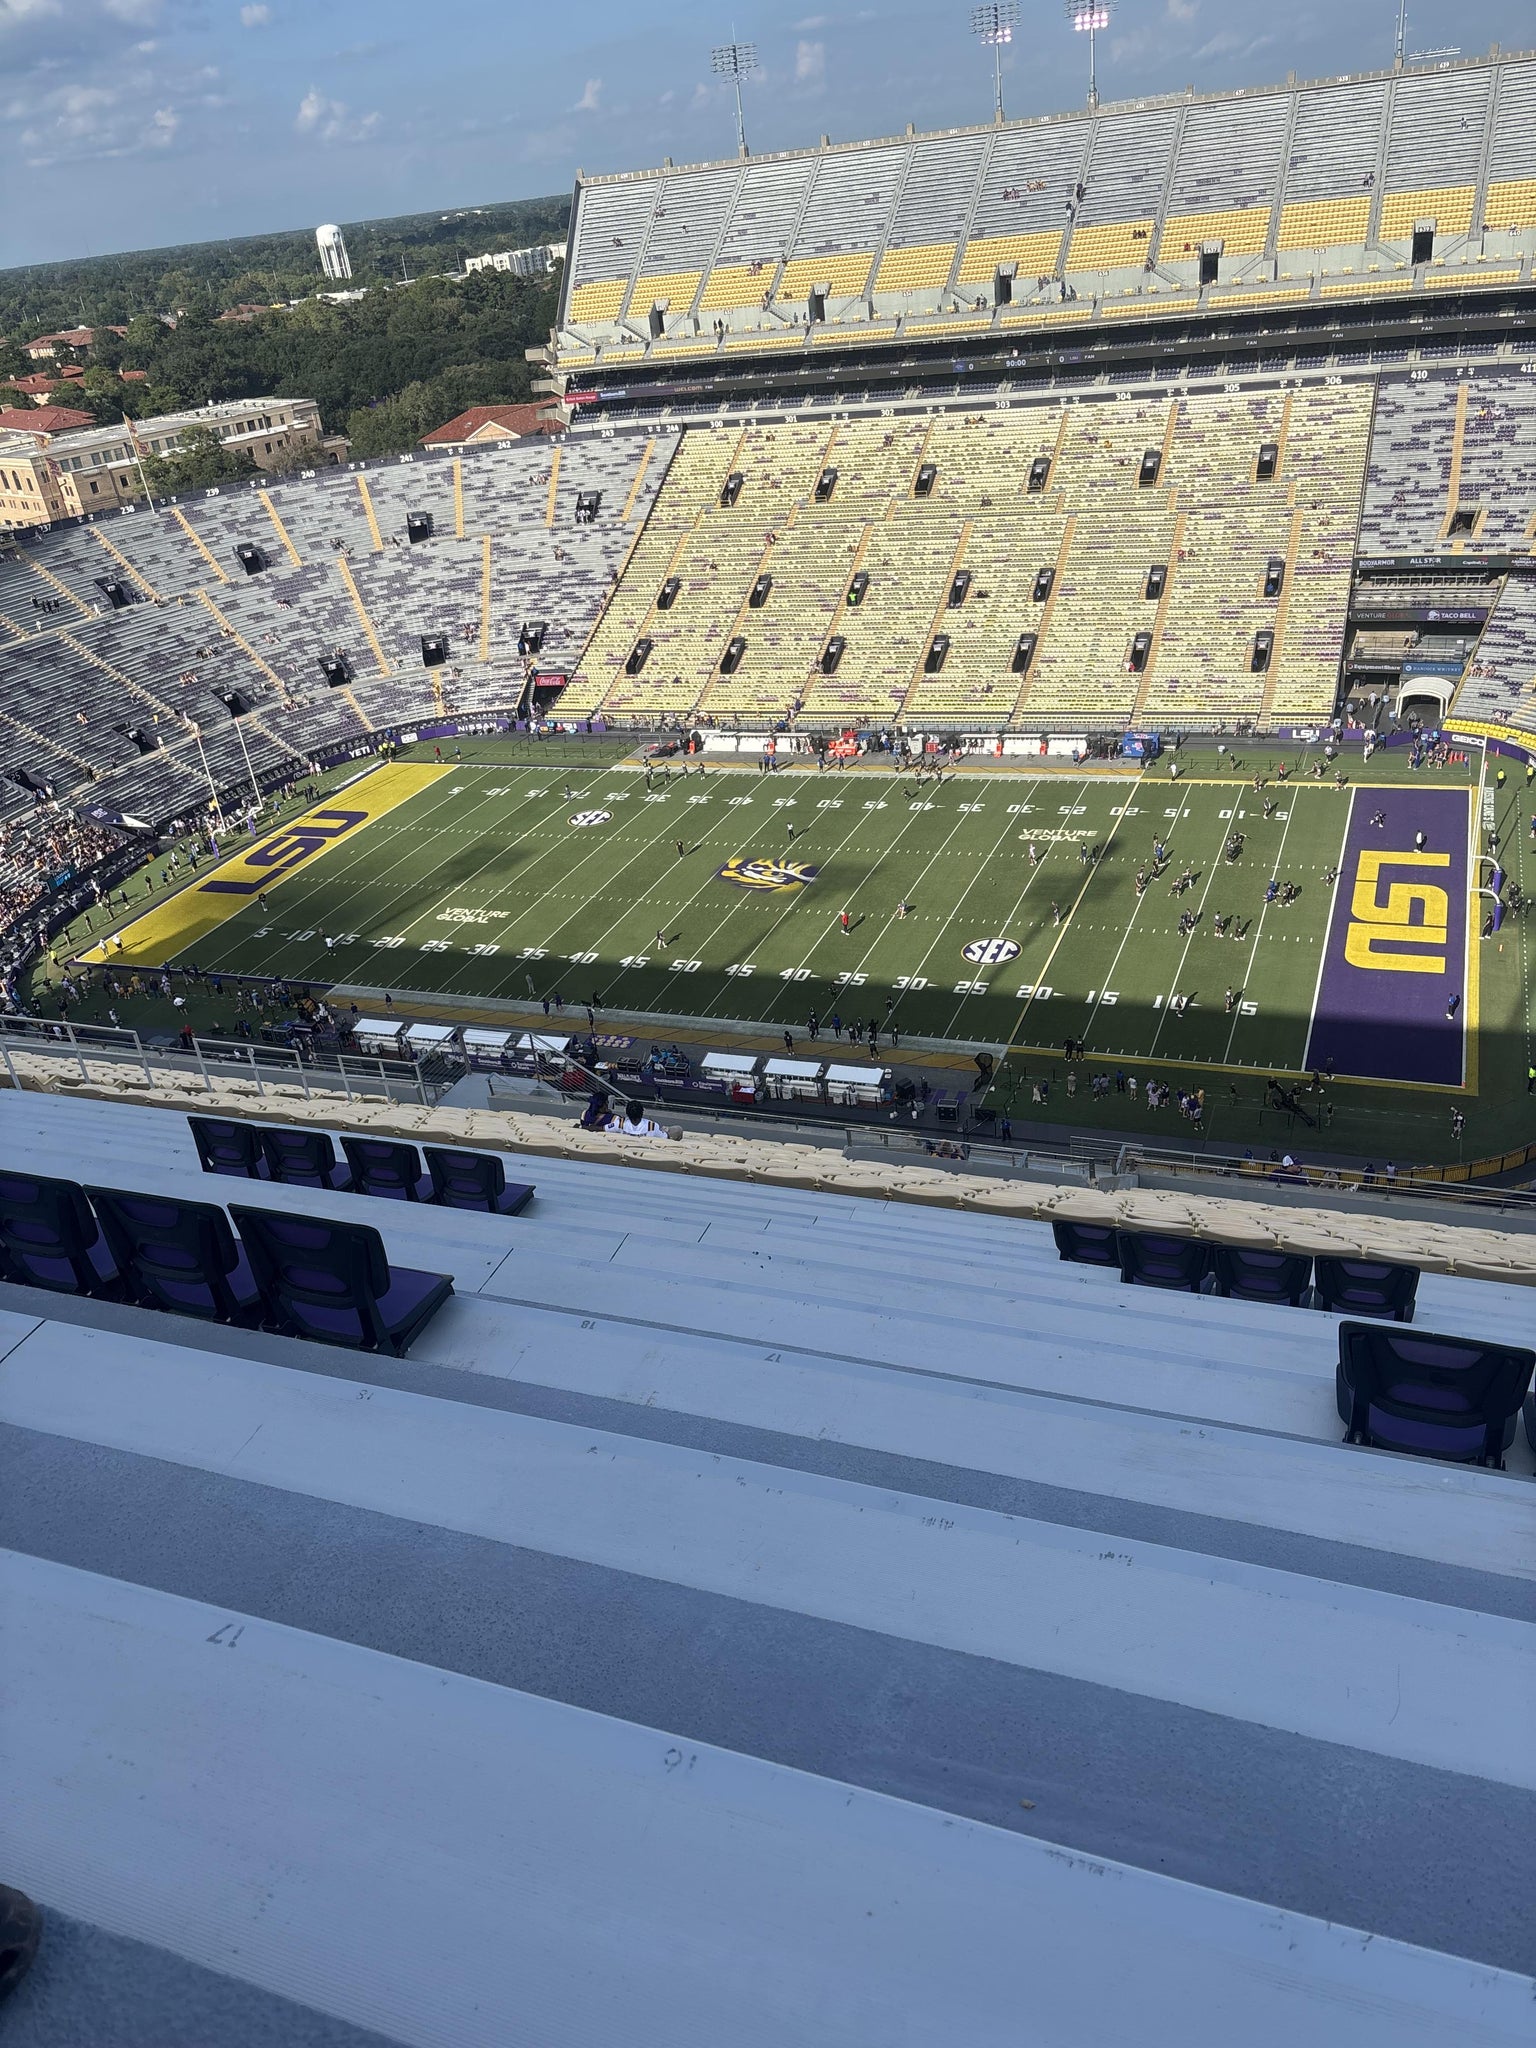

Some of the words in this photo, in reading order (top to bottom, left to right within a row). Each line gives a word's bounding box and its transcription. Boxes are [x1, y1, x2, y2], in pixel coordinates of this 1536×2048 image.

[1005, 359, 1027, 367] 90:00
[1410, 370, 1428, 379] 410
[1324, 376, 1342, 385] 306
[1223, 383, 1241, 393] 305
[1115, 391, 1132, 401] 304
[995, 401, 1011, 410] 303
[881, 408, 894, 417] 302
[709, 420, 724, 429] 300
[784, 415, 798, 424] 301
[601, 429, 615, 438] 243
[665, 424, 679, 433] 244
[497, 441, 512, 449] 242
[399, 454, 414, 463] 241
[301, 470, 316, 479] 240
[205, 488, 220, 497] 239
[119, 505, 135, 515] 238
[1359, 559, 1395, 567] BODYARMOR
[1353, 663, 1402, 671] EquipmentShare
[457, 722, 498, 732] NISSAN
[1291, 728, 1321, 739] LSU
[1451, 734, 1485, 747] GEICO
[348, 745, 371, 759] YETI
[486, 788, 511, 796] 10
[524, 789, 549, 798] 15
[603, 792, 631, 801] 25
[644, 794, 671, 803] 30
[686, 795, 713, 804] 35
[728, 796, 755, 805] 40
[771, 798, 798, 807] 45
[816, 799, 844, 809] 50
[861, 801, 889, 810] 45
[908, 801, 936, 811] 40
[956, 803, 986, 813] 35
[1006, 804, 1036, 814] 30
[1057, 805, 1087, 815] 25
[1109, 806, 1140, 816] 20
[1162, 808, 1191, 818] 15
[1218, 809, 1246, 819] 10
[570, 810, 611, 826] SEC
[1022, 828, 1098, 838] VENTURE
[1018, 834, 1081, 843] GLOBAL
[196, 809, 370, 895] LSU
[445, 906, 511, 919] VENTURE
[1343, 849, 1451, 974] LSU
[435, 913, 489, 924] GLOBAL
[965, 938, 1019, 964] SEC
[254, 927, 274, 939] 5
[286, 930, 317, 942] 10
[332, 933, 362, 945] 15
[373, 936, 407, 949] 20
[419, 940, 453, 953] 25
[467, 944, 501, 956] 30
[516, 948, 550, 960] 35
[568, 952, 600, 964] 40
[619, 956, 651, 969] 45
[668, 959, 703, 973] 50
[724, 964, 757, 977] 45
[779, 968, 812, 981] 40
[834, 972, 869, 986] 35
[892, 976, 928, 991] 30
[953, 980, 990, 995] 25
[1015, 985, 1053, 1000] 20
[1085, 990, 1120, 1005] 15
[1152, 995, 1187, 1010] 10
[1240, 1001, 1259, 1016] 5
[580, 1320, 597, 1330] 18
[764, 1352, 782, 1363] 17
[205, 1624, 246, 1649] 17
[664, 1748, 698, 1775] 16
